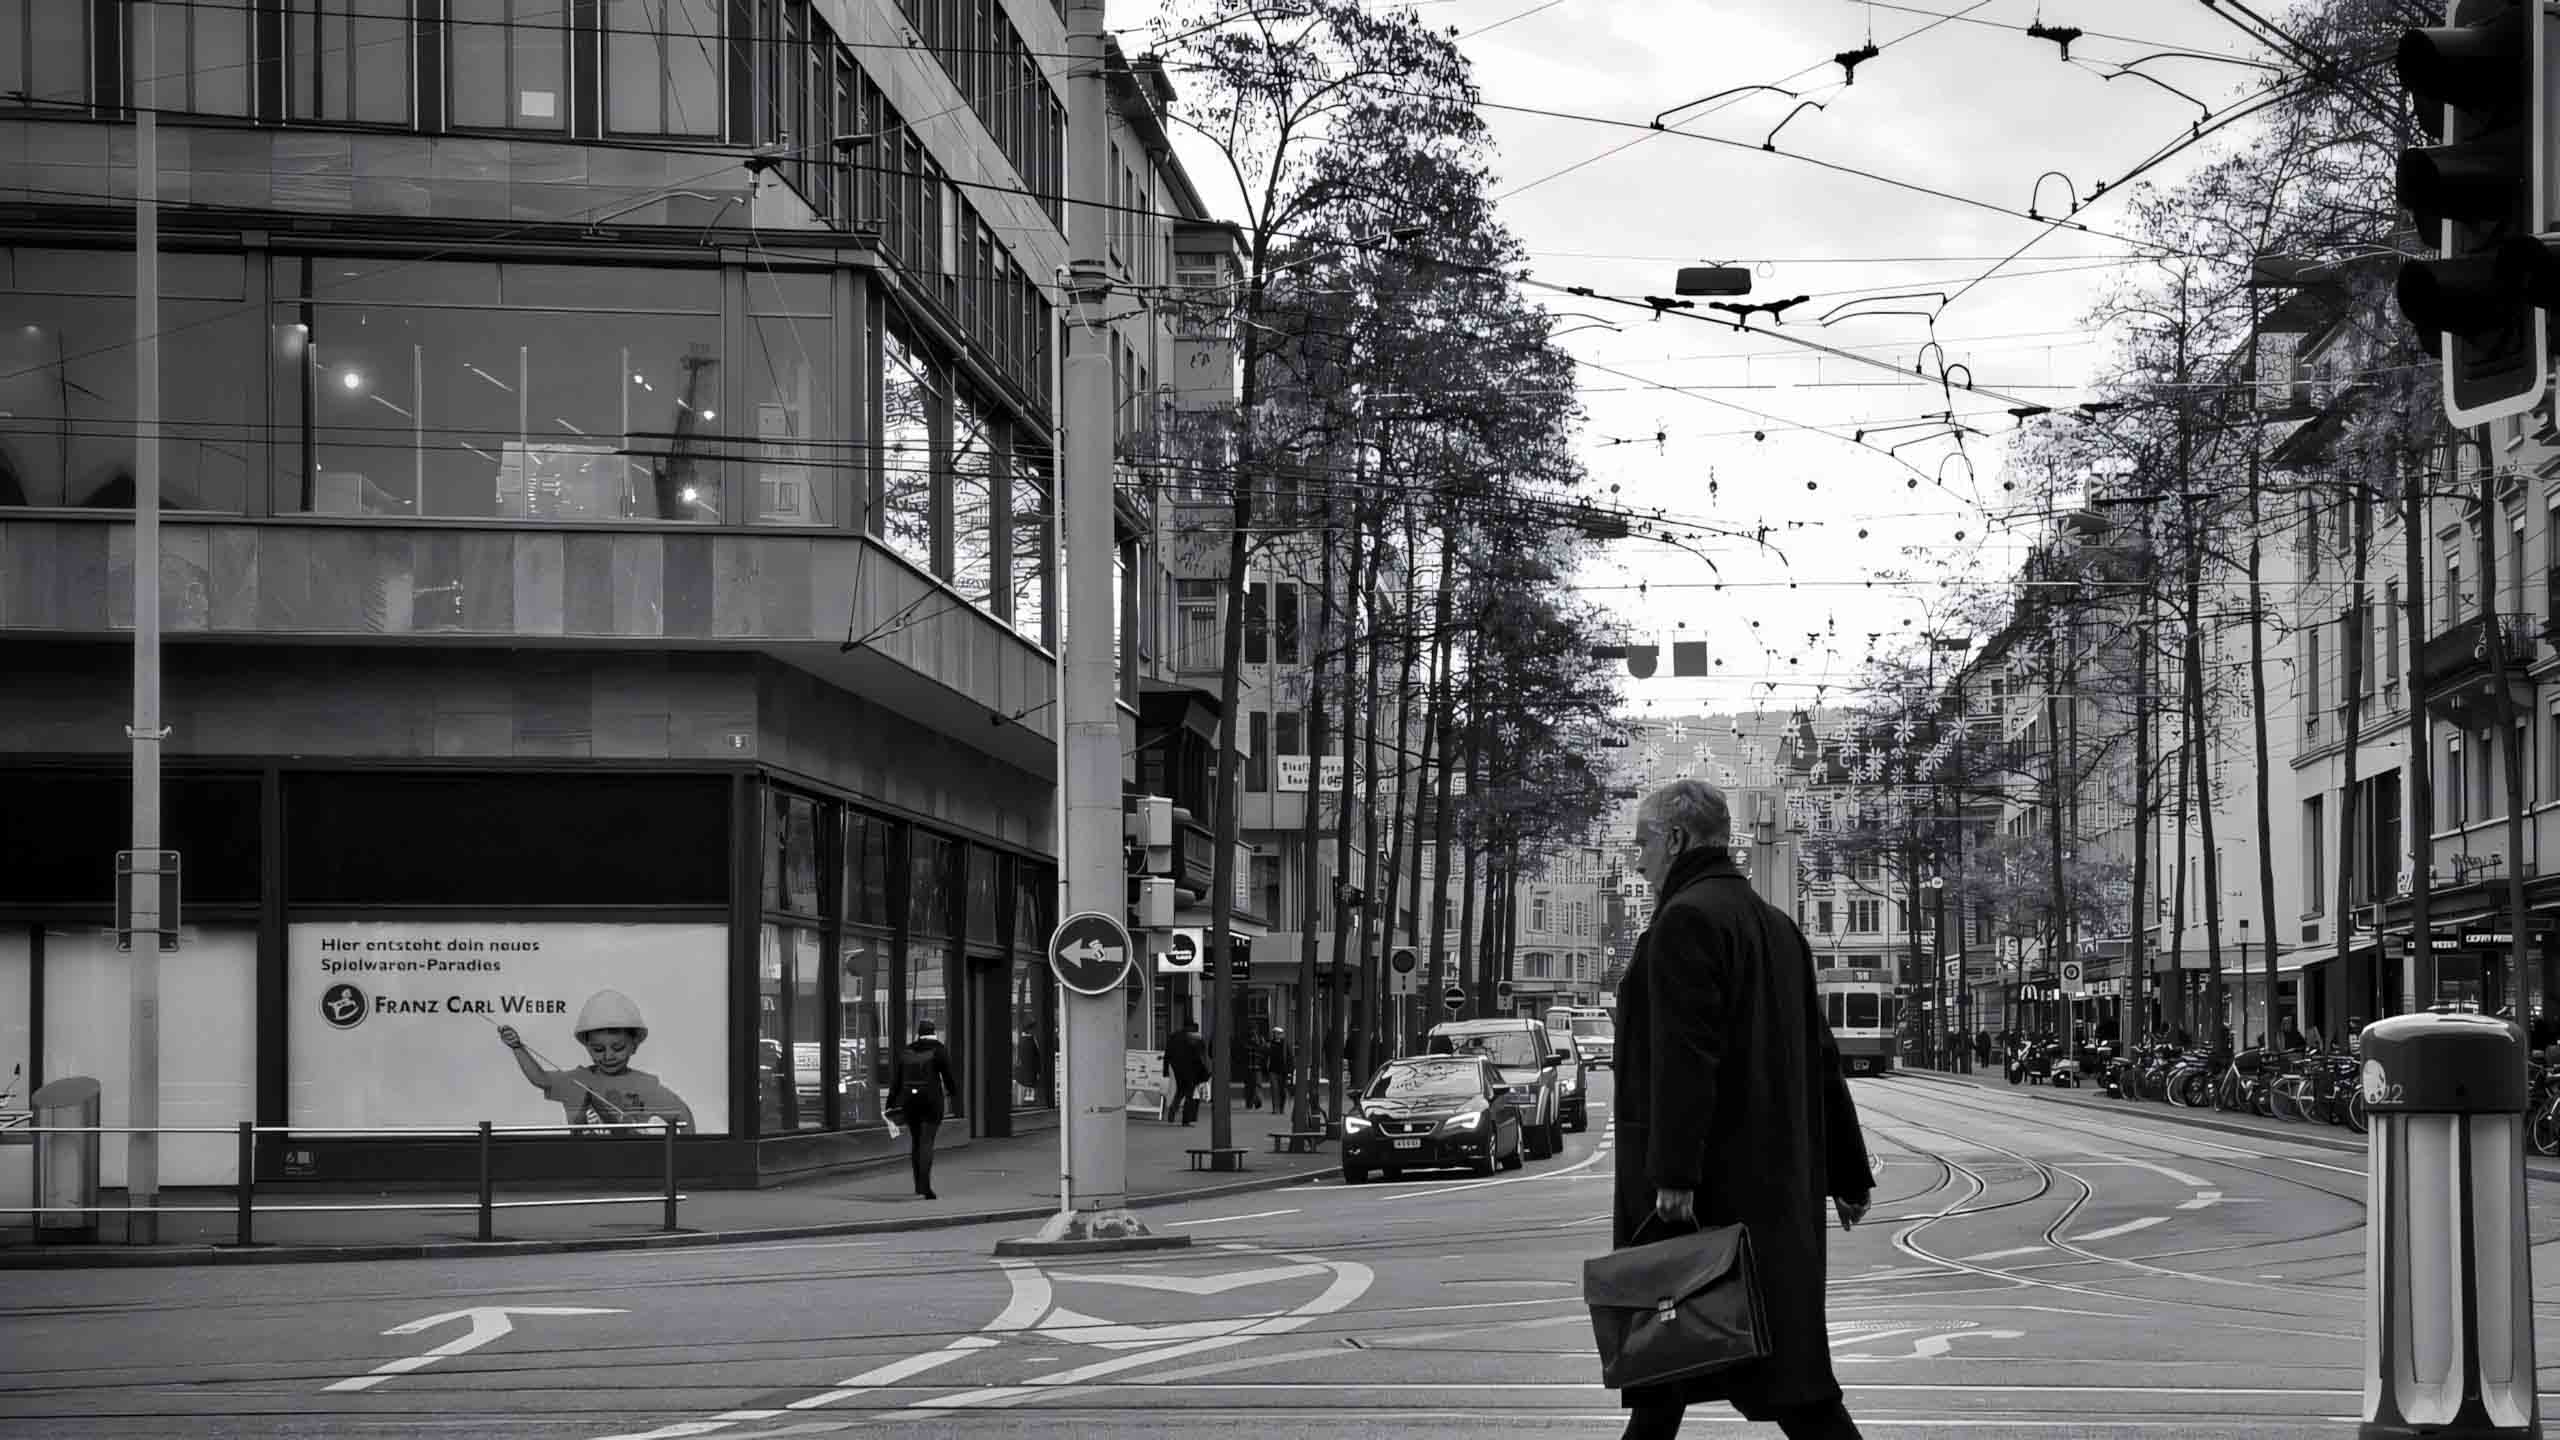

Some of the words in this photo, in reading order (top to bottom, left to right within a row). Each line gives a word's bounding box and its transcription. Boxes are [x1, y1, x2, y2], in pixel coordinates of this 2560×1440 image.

[321, 938, 361, 951] Hier
[366, 938, 441, 951] entsteht
[447, 938, 484, 951] dein
[489, 941, 541, 952] neues
[321, 958, 501, 975] Spielwaren-Paradies
[375, 995, 440, 1014] FRANZ
[446, 995, 496, 1014] CARL
[500, 995, 567, 1014] WEBER
